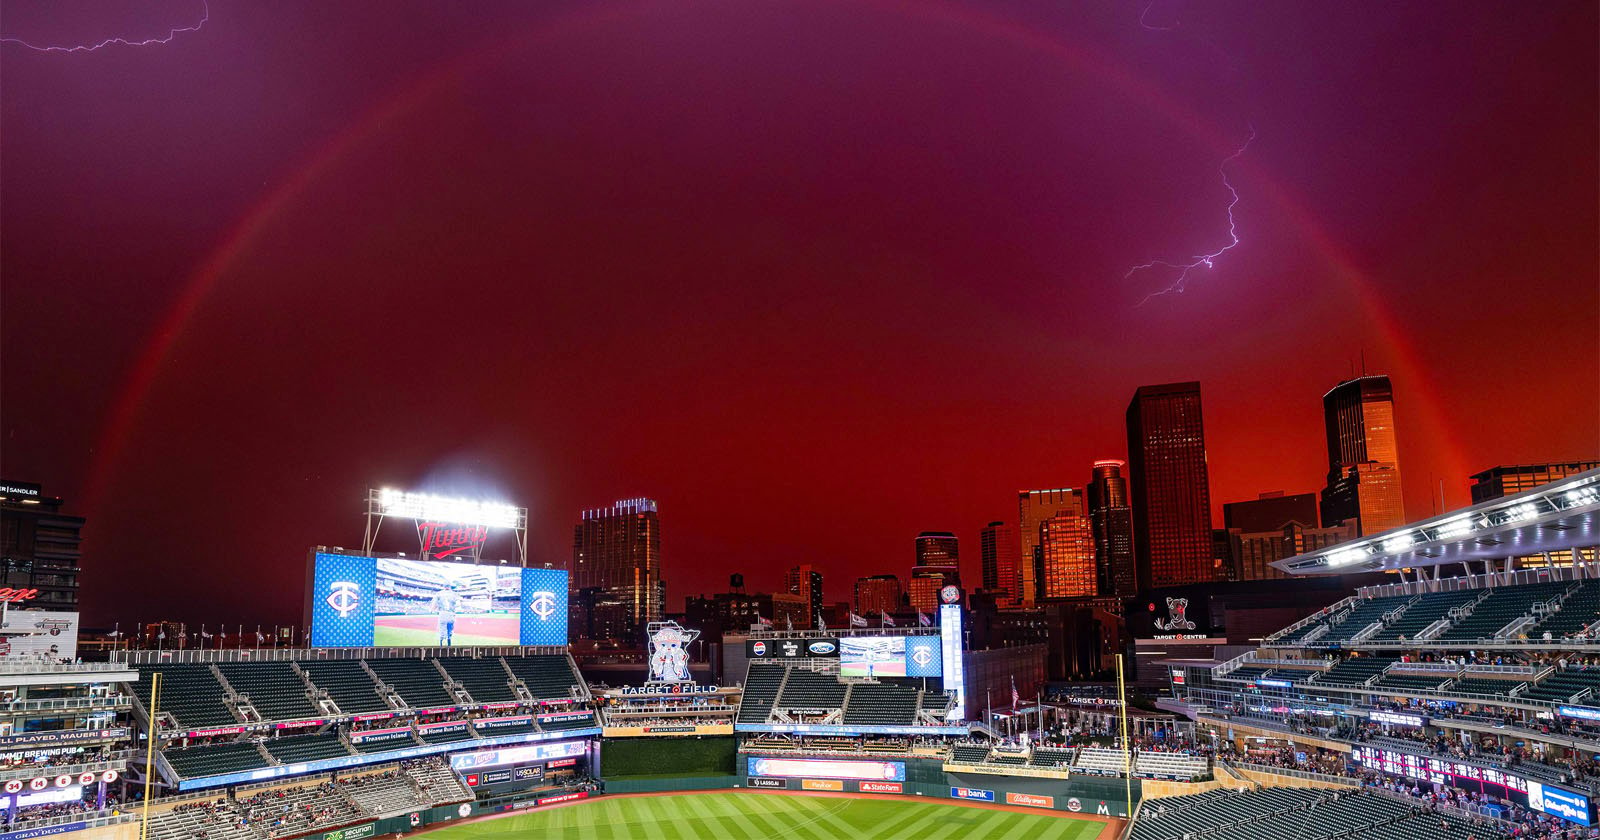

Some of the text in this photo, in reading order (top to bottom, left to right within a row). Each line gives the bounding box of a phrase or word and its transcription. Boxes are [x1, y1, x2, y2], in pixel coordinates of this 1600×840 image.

[418, 522, 487, 552] Twins
[622, 685, 718, 694] TARGET FIELD
[16, 734, 58, 743] PLAYED,
[25, 748, 60, 758] BREWING
[474, 752, 496, 764] Twins
[968, 790, 986, 798] bank
[1014, 794, 1032, 804] Bally
[1097, 804, 1110, 815] M
[15, 830, 41, 839] GRAY
[42, 827, 65, 835] DUCK
[345, 825, 372, 836] securian
